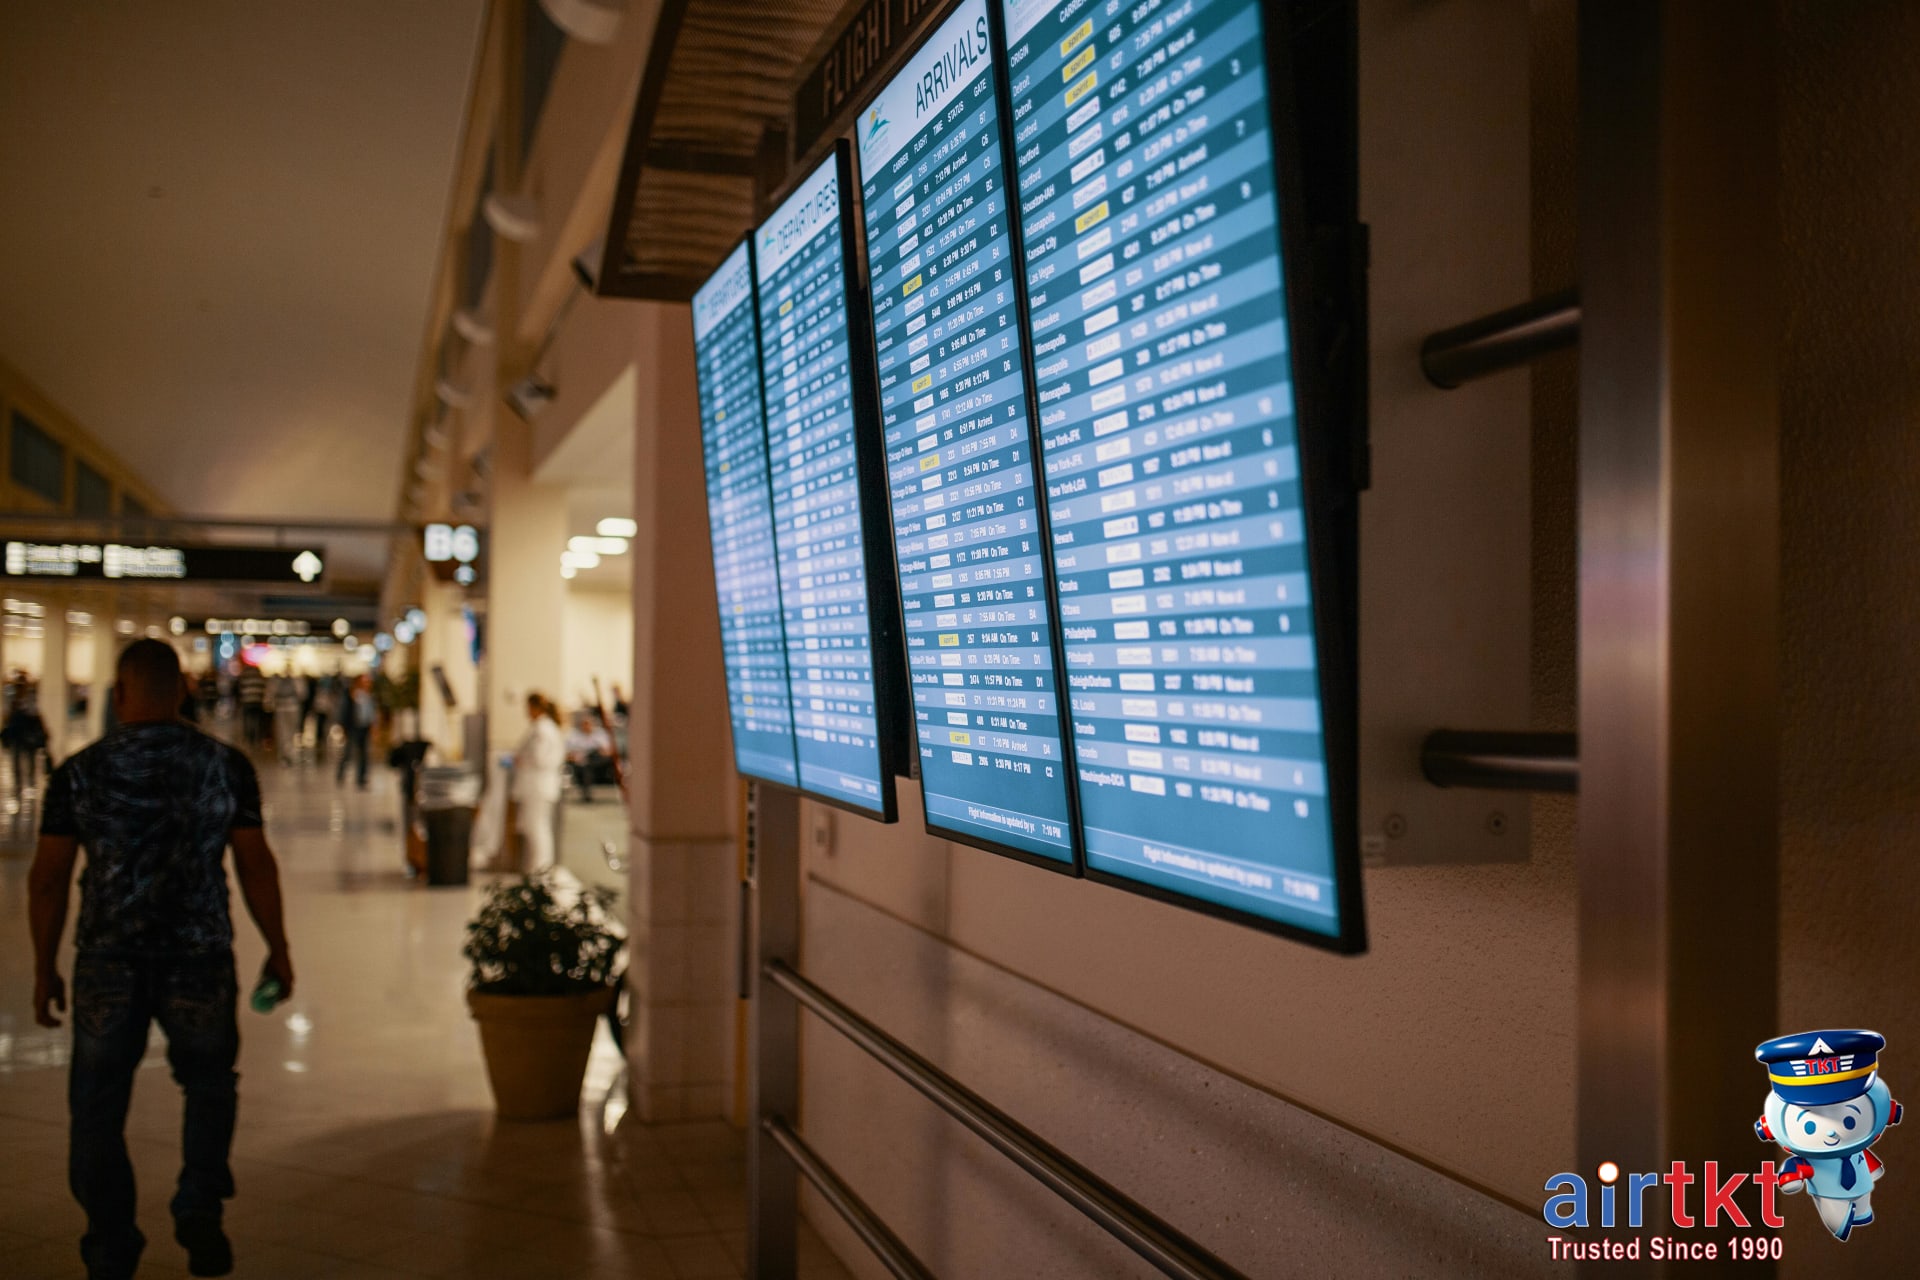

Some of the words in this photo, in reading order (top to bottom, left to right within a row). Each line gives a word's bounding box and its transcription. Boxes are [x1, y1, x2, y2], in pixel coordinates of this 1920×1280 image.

[916, 15, 988, 119] ARRIVALS
[948, 101, 964, 122] STATUS
[974, 78, 986, 96] GATE
[424, 523, 479, 562] B6
